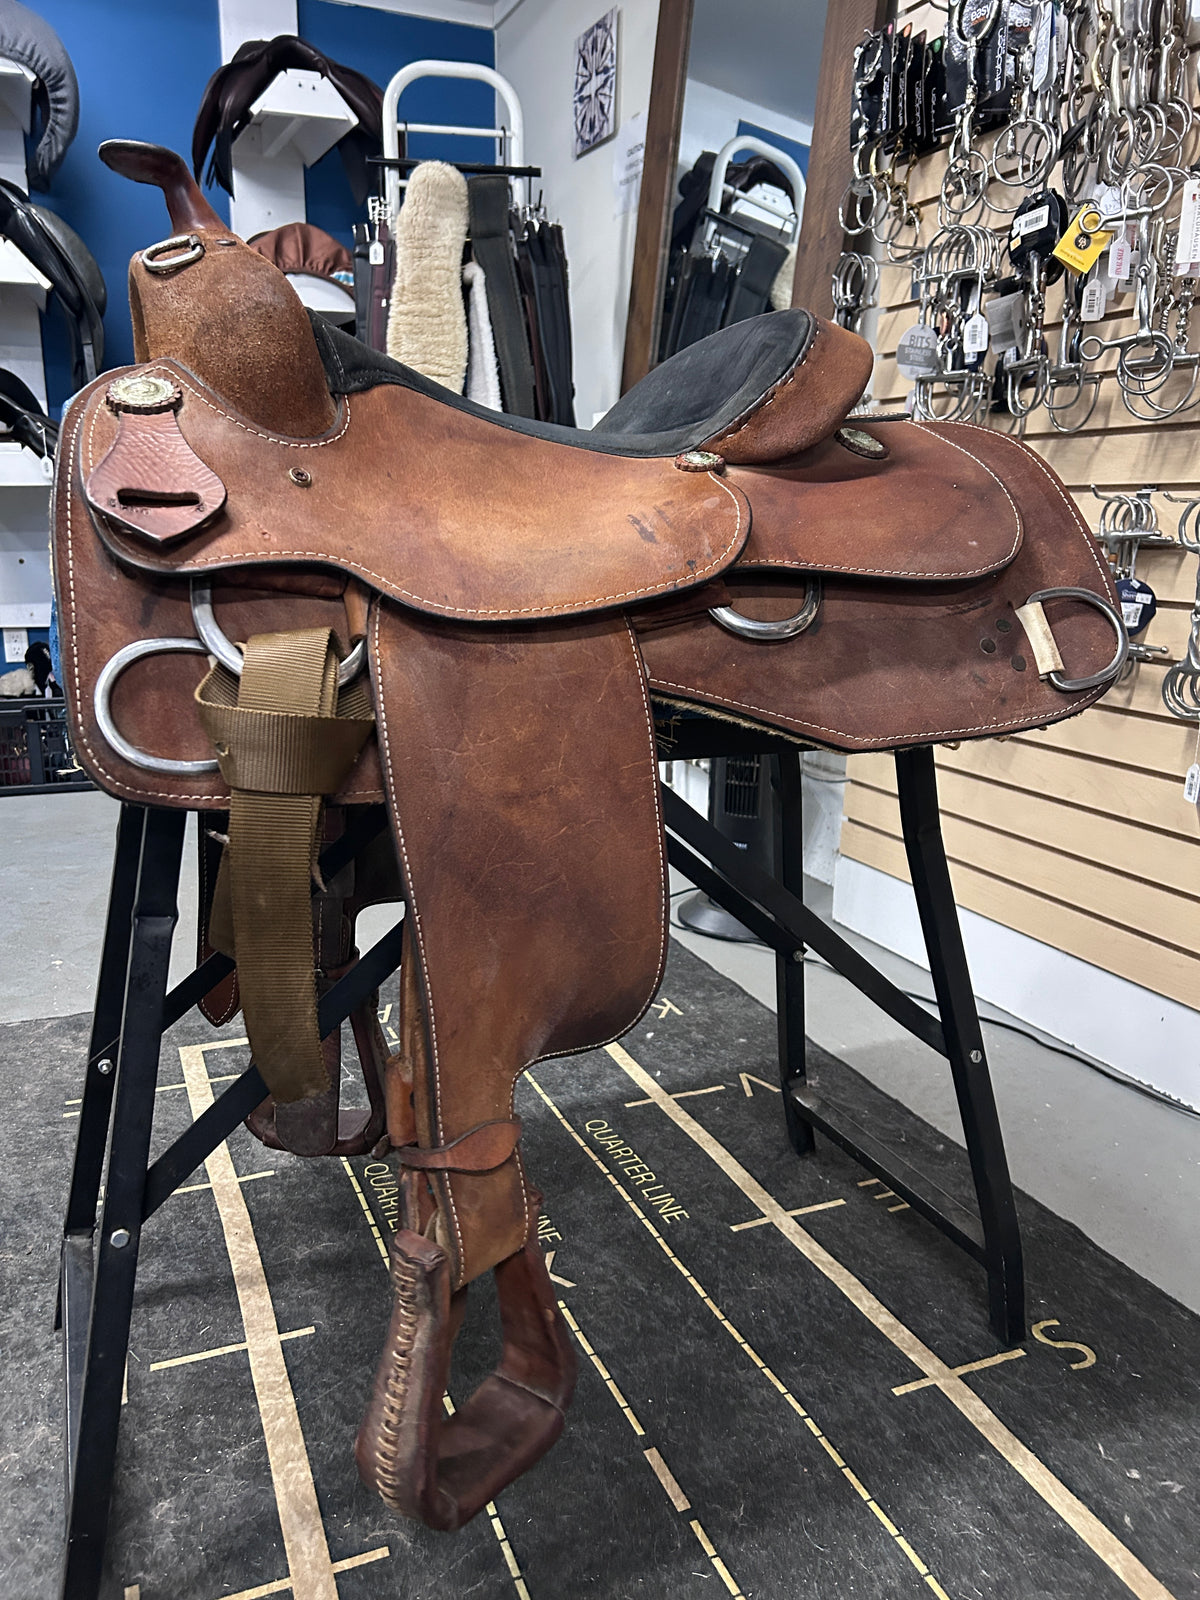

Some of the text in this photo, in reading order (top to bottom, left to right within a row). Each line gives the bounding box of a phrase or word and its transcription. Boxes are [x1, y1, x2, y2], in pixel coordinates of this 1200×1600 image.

[909, 334, 931, 349] BITS
[364, 1163, 399, 1233] QUAR
[585, 1119, 690, 1224] QUARTER LINE
[1031, 1319, 1097, 1371] S
